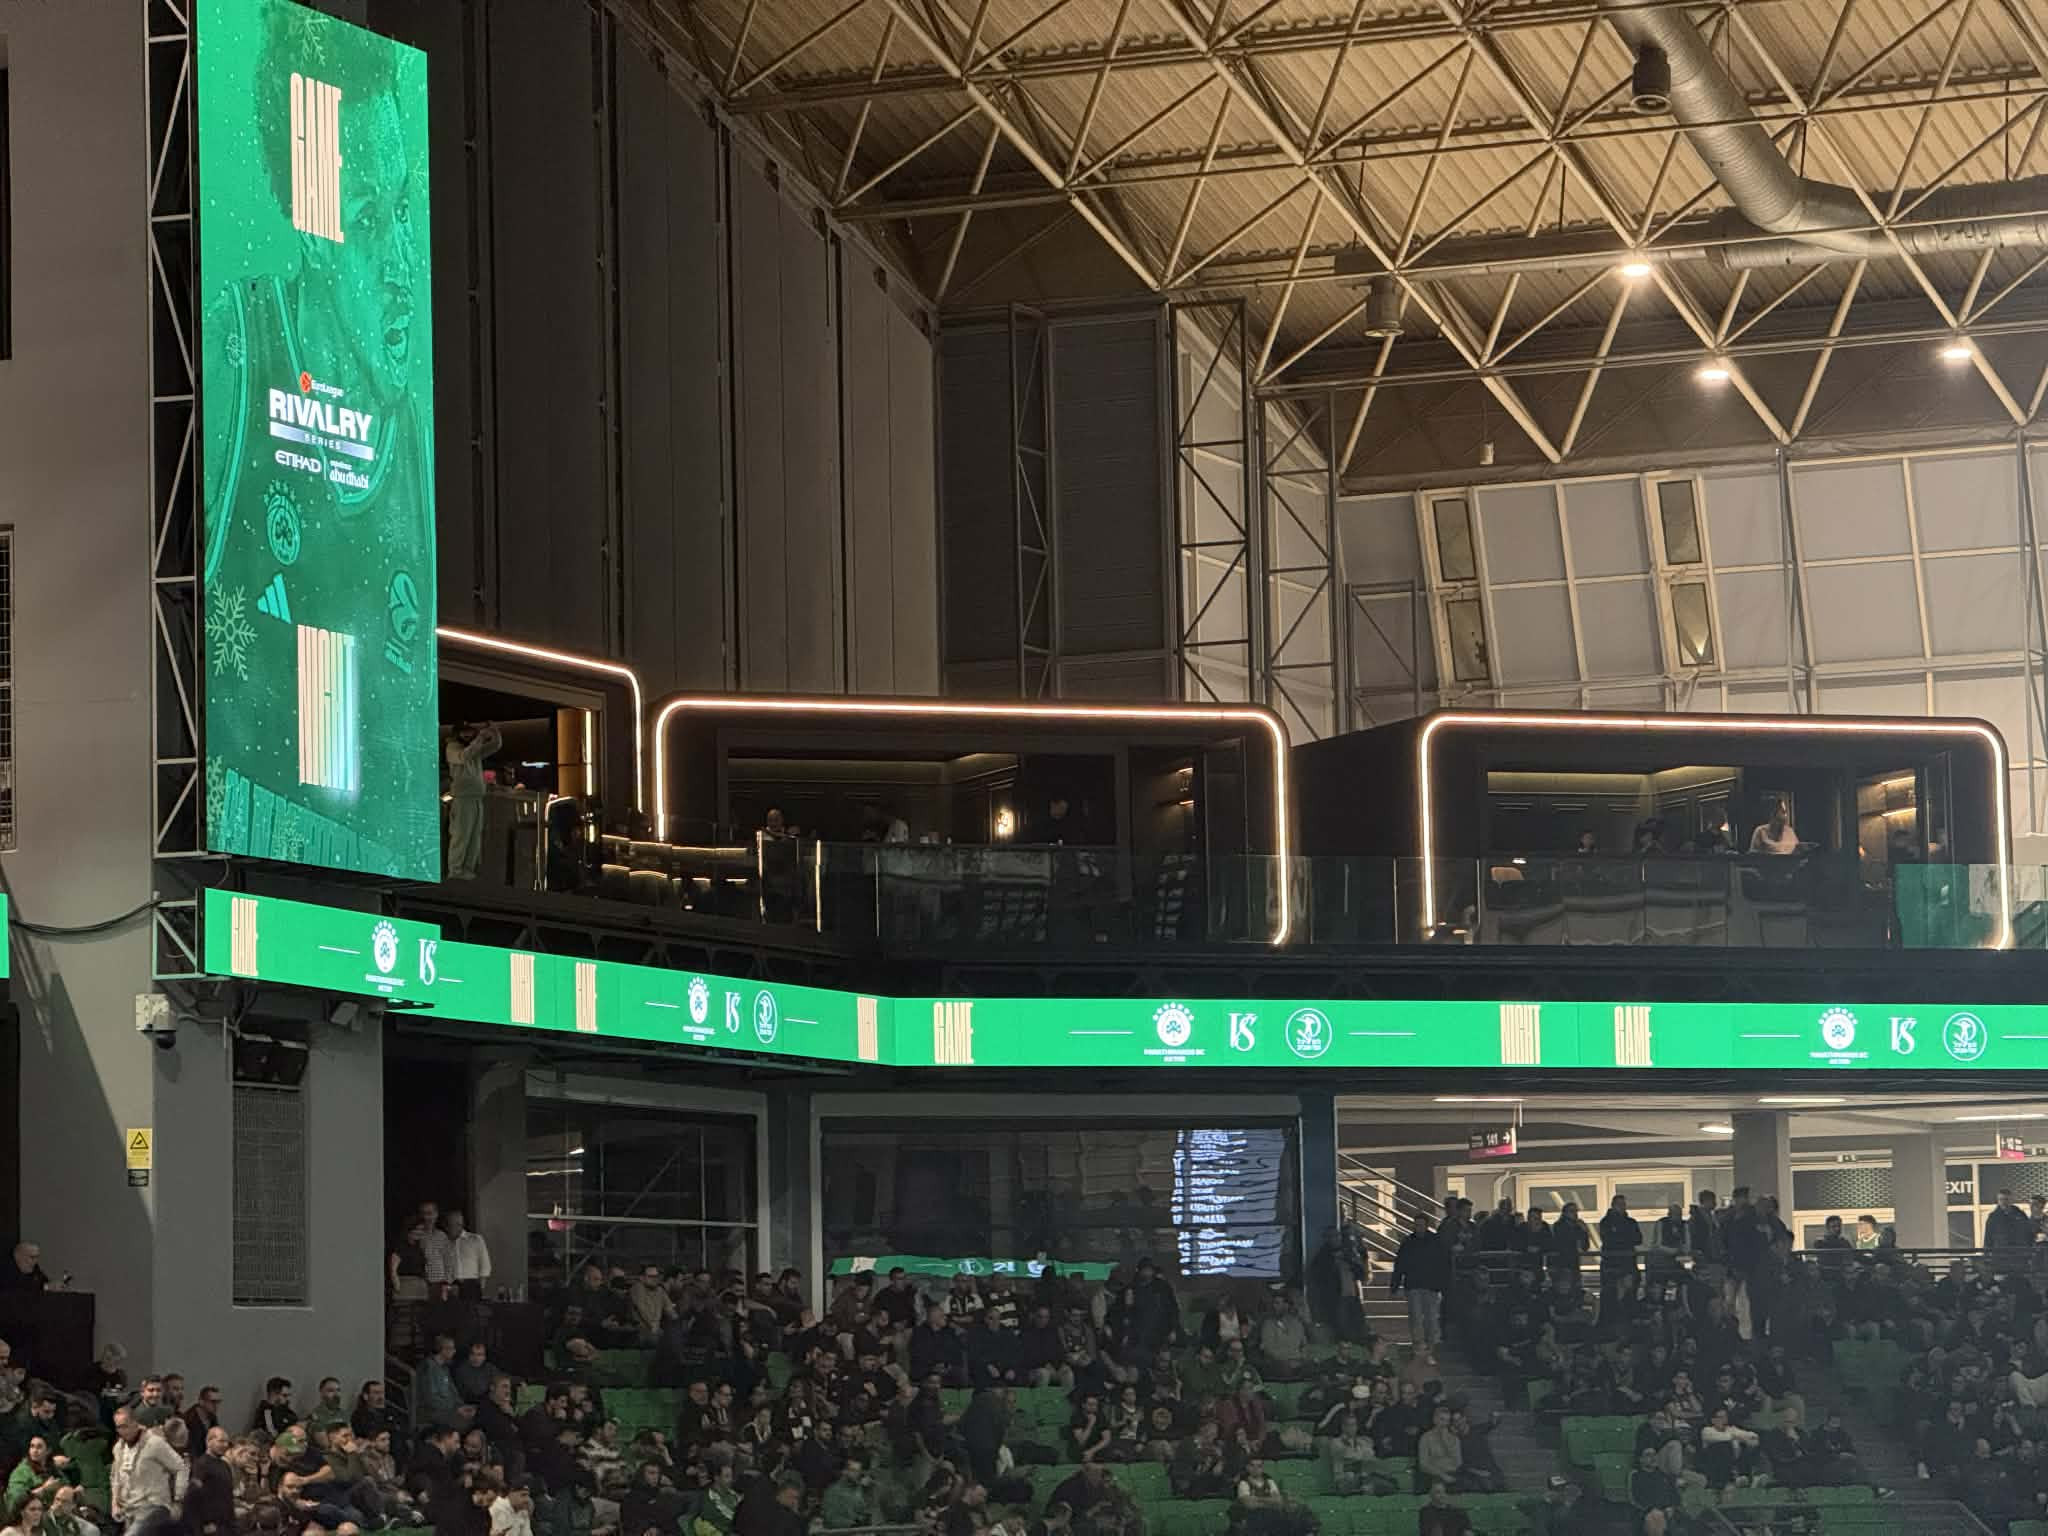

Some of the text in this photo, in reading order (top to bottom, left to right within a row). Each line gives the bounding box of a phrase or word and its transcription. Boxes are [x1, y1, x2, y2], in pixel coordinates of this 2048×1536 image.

[269, 387, 373, 442] RIVALRY
[275, 449, 322, 473] ETIHAD
[304, 433, 340, 450] SERIES
[418, 938, 437, 985] VS
[725, 991, 741, 1033] VS
[1228, 1012, 1258, 1052] VS
[933, 1001, 975, 1066] GAME
[1889, 1016, 1917, 1055] VS
[1945, 1181, 1973, 1194] EXIT
